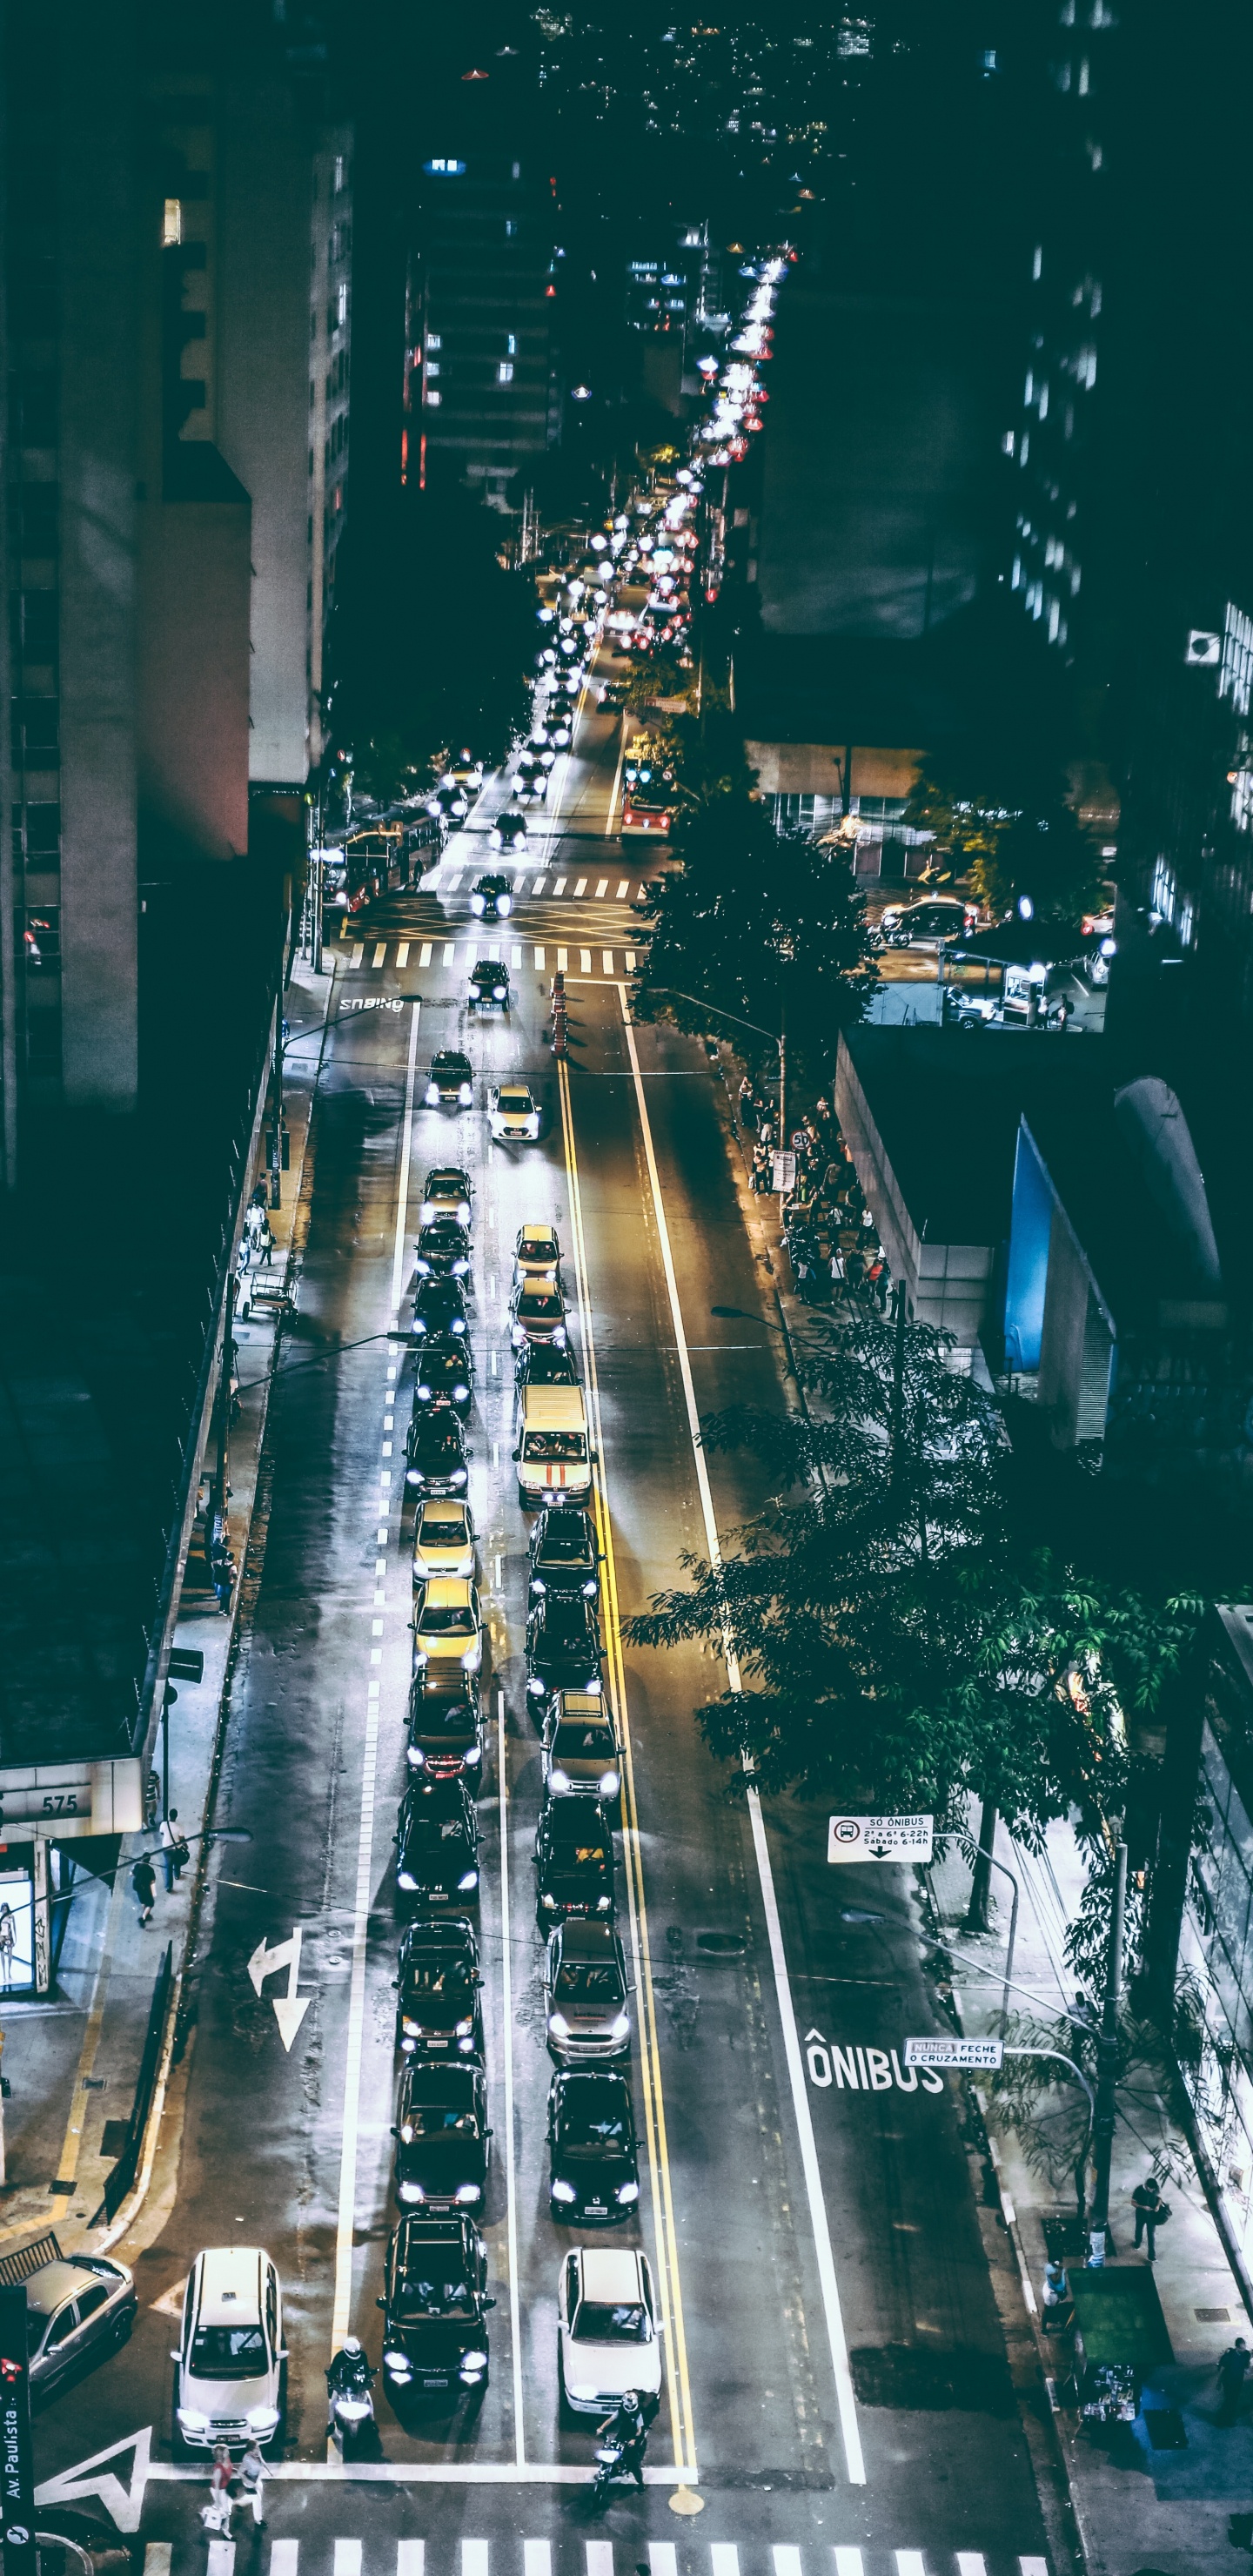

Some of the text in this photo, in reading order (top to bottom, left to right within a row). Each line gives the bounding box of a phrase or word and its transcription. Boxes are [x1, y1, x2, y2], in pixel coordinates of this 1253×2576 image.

[338, 997, 405, 1013] ÔNIBUS
[794, 1135, 809, 1145] 50
[44, 1794, 77, 1815] 575
[870, 1816, 924, 1827] SÓ ÔNIBUS
[914, 2043, 996, 2054] NUNCA FECHE
[804, 2028, 944, 2094] ÔNIBUS
[921, 2055, 997, 2064] CRUZAMENTO
[3, 2410, 21, 2499] Av. Paulista
